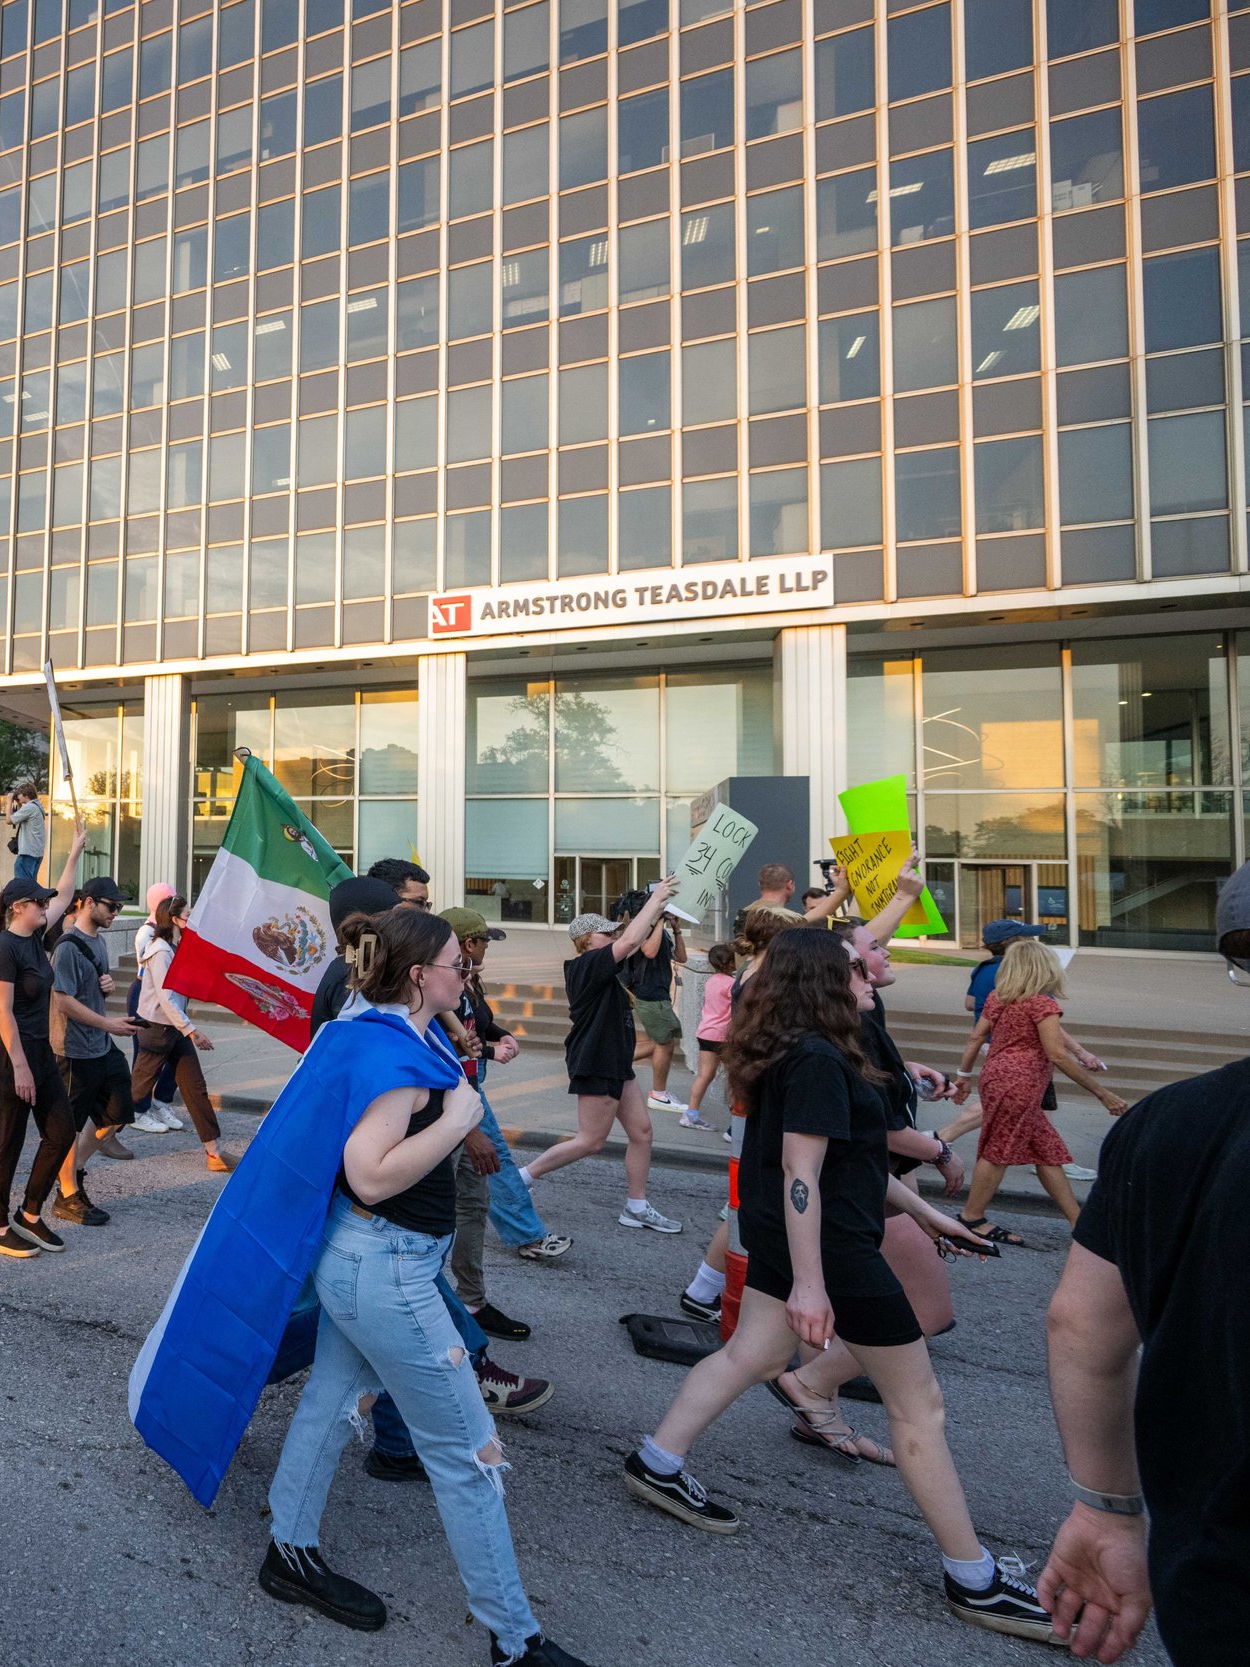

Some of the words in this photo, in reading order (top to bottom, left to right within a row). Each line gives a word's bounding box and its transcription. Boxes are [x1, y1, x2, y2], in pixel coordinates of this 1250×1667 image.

[480, 588, 628, 621] ARMSTRONG
[635, 575, 770, 607] TEASDALE
[779, 569, 828, 594] LLP
[712, 813, 752, 849] LOCK
[688, 842, 717, 872] 34
[716, 857, 733, 879] CO
[836, 837, 864, 866] FIGHT
[865, 874, 880, 897] NOT
[871, 877, 898, 915] IMMIGRA
